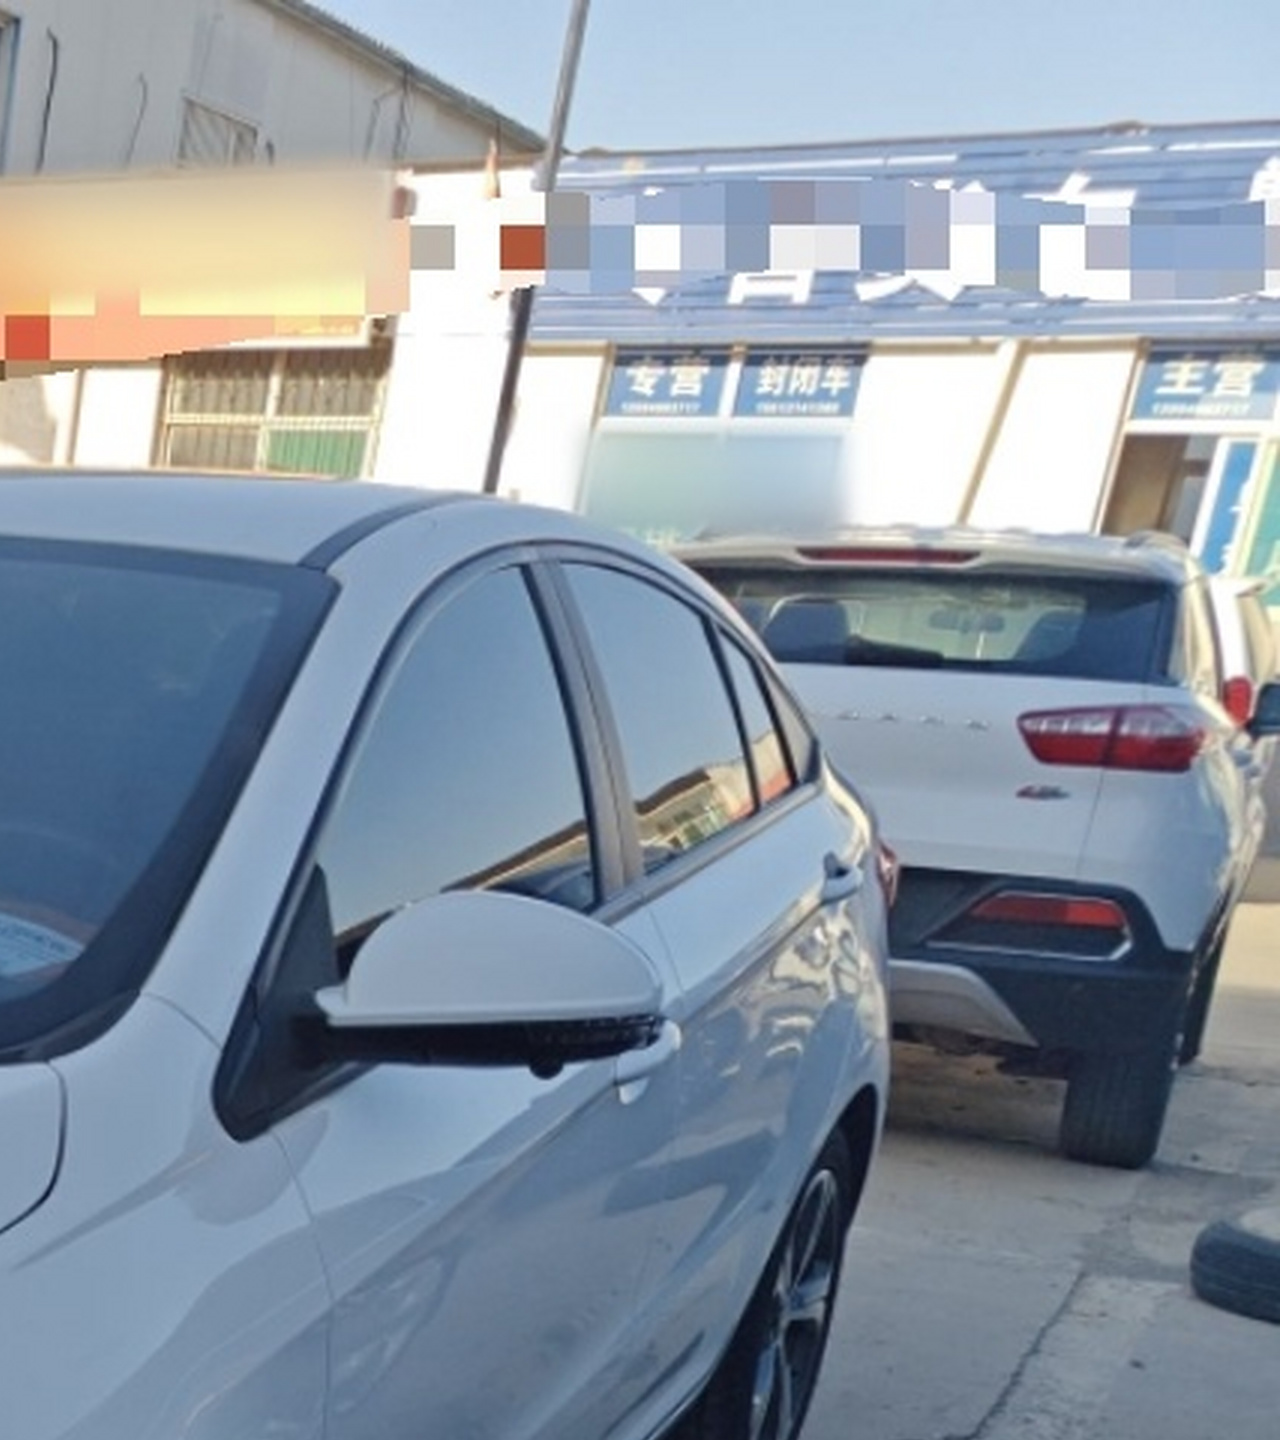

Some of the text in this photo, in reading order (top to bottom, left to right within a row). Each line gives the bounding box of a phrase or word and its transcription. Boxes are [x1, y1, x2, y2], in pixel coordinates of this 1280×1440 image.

[625, 355, 853, 397] 专营 封闭车
[1154, 353, 1266, 397] 主营
